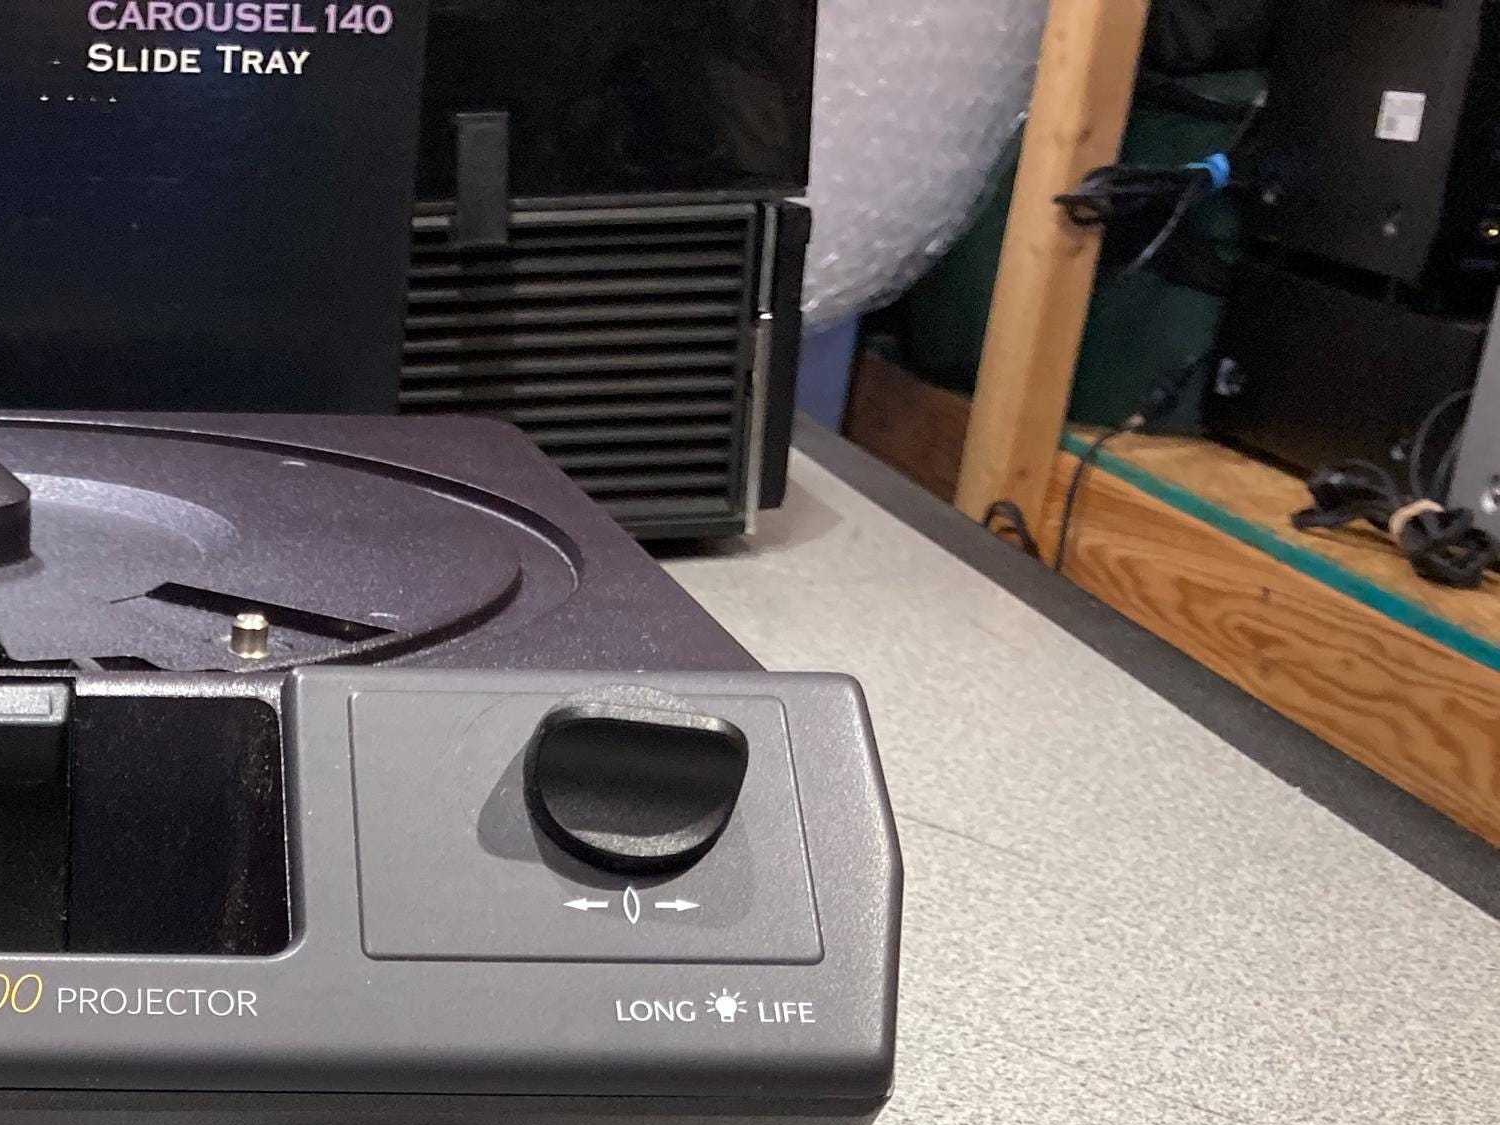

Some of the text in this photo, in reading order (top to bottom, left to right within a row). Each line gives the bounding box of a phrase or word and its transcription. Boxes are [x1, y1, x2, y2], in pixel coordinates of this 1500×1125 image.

[87, 1, 393, 34] CAROUSEL 140
[87, 43, 310, 75] SLIDE TRAY
[57, 987, 258, 1017] PROJECTOR
[615, 1000, 816, 1023] LONG LIFE
